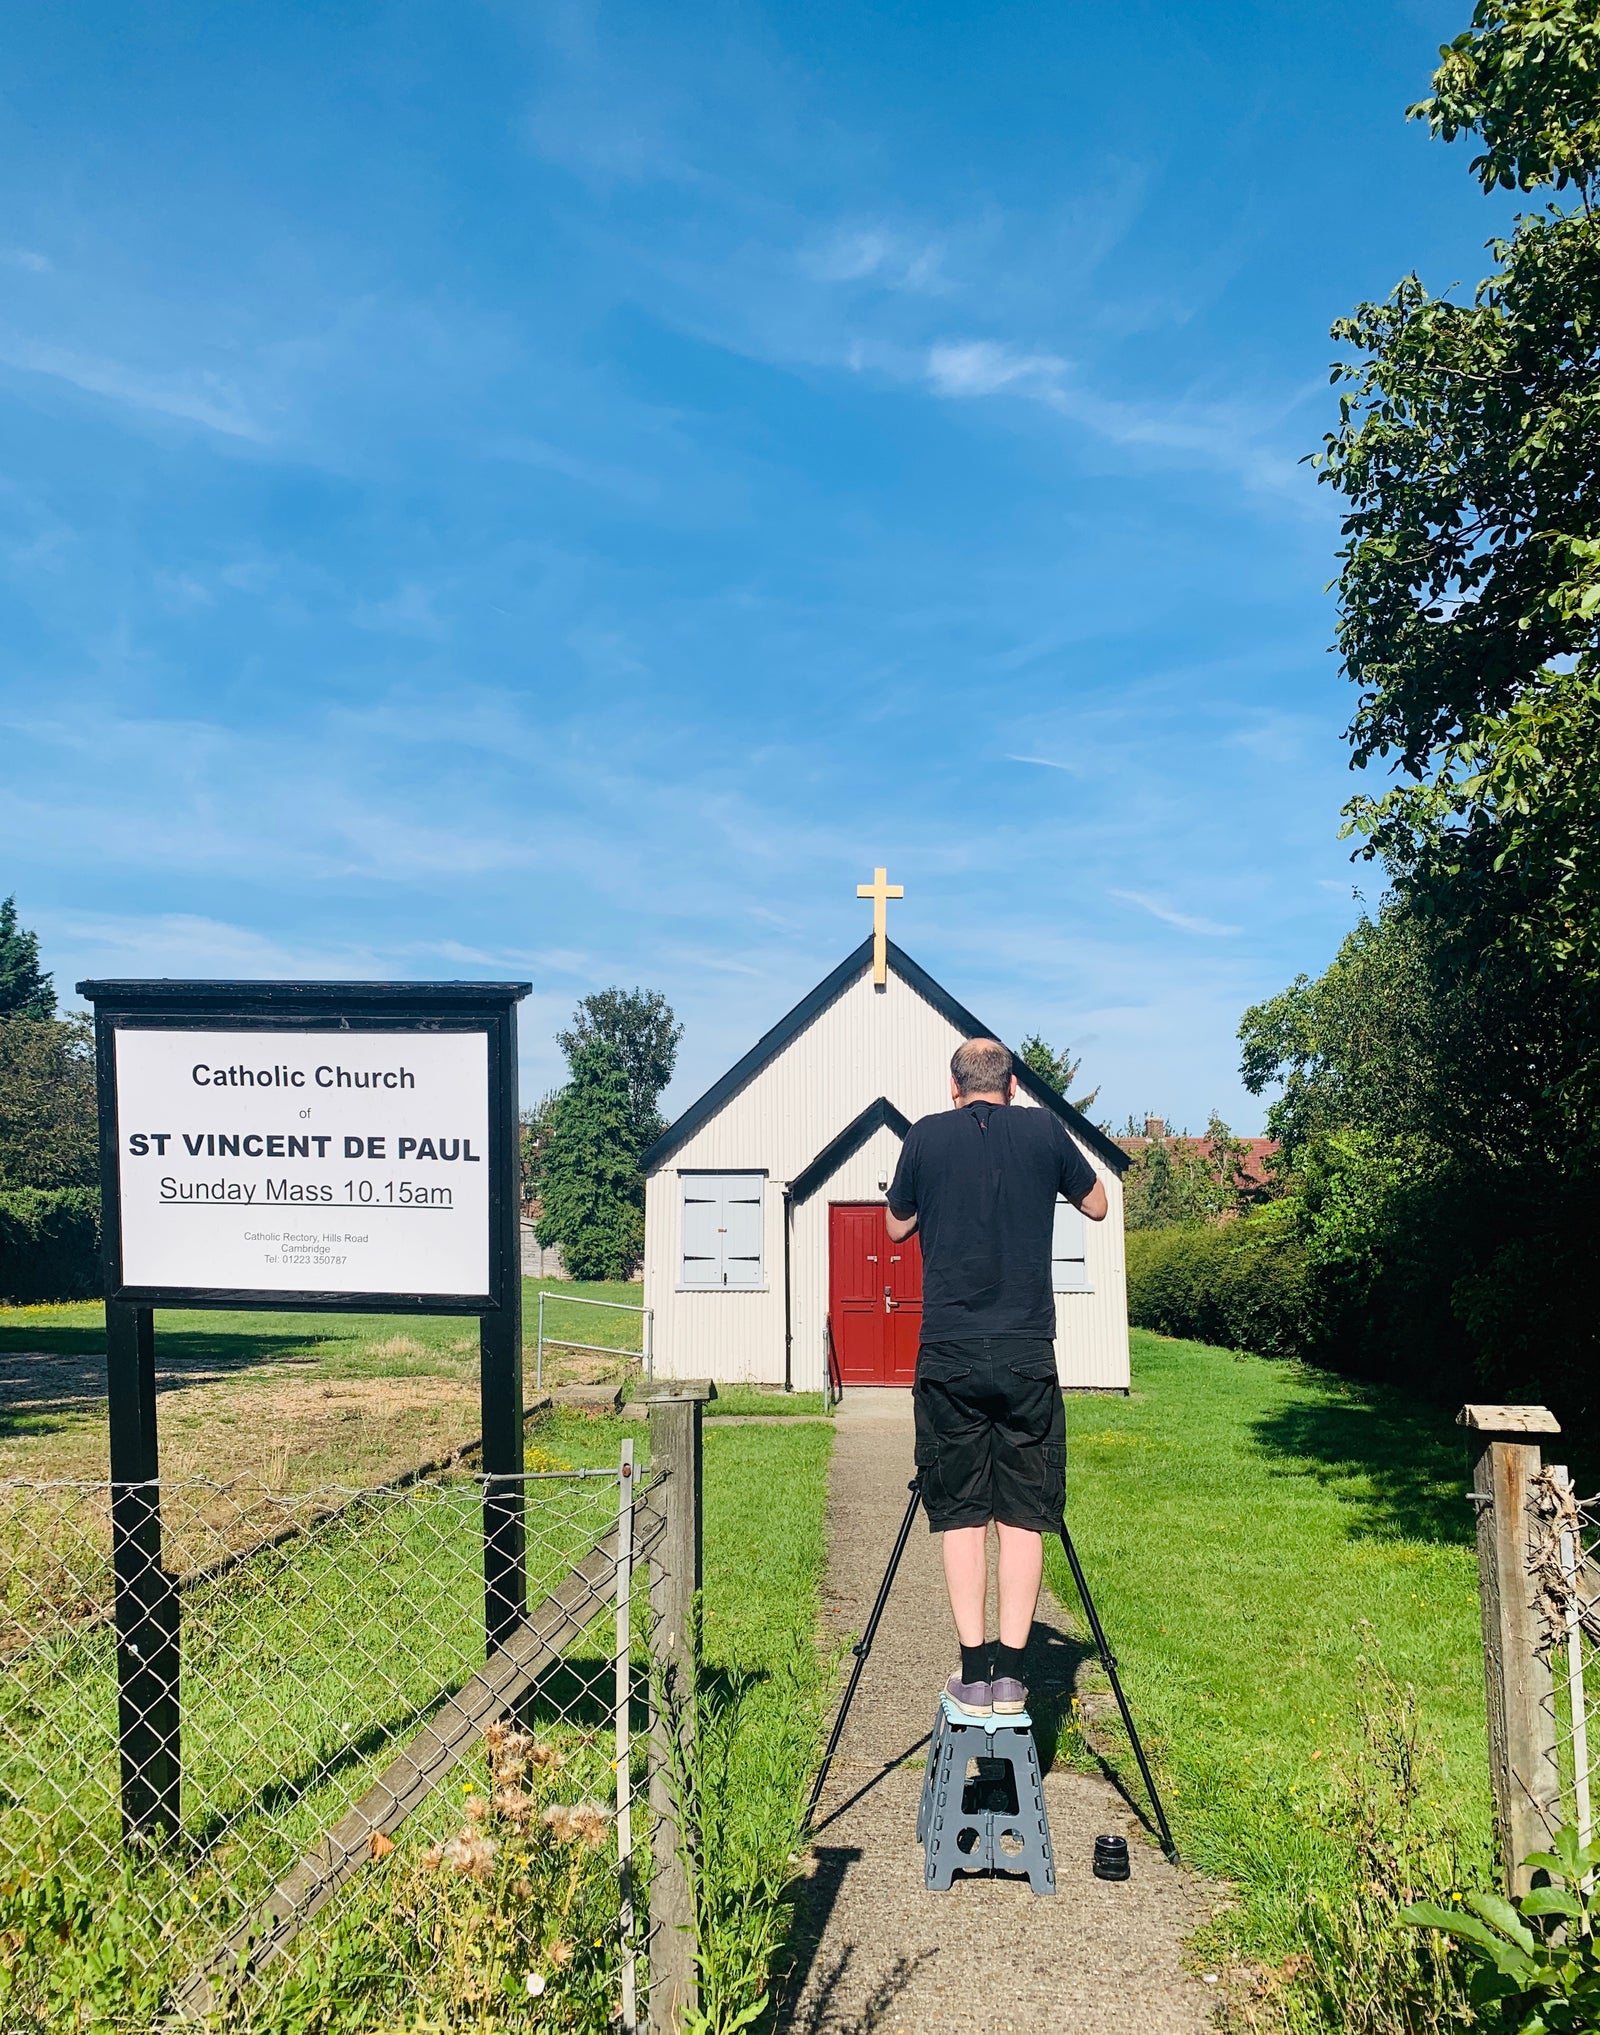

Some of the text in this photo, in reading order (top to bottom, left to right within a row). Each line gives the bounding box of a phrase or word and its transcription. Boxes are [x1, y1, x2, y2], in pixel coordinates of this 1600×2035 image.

[192, 1064, 415, 1088] Catholic Church
[299, 1108, 311, 1119] of
[129, 1134, 480, 1162] ST VINCENT DE PAUL
[159, 1177, 452, 1205] Sunday Mass 10.15am
[244, 1232, 368, 1244] Catholic Rectory, Hills Road
[281, 1243, 330, 1255] Cambridge
[264, 1254, 347, 1264] Tel: 01223 350787
